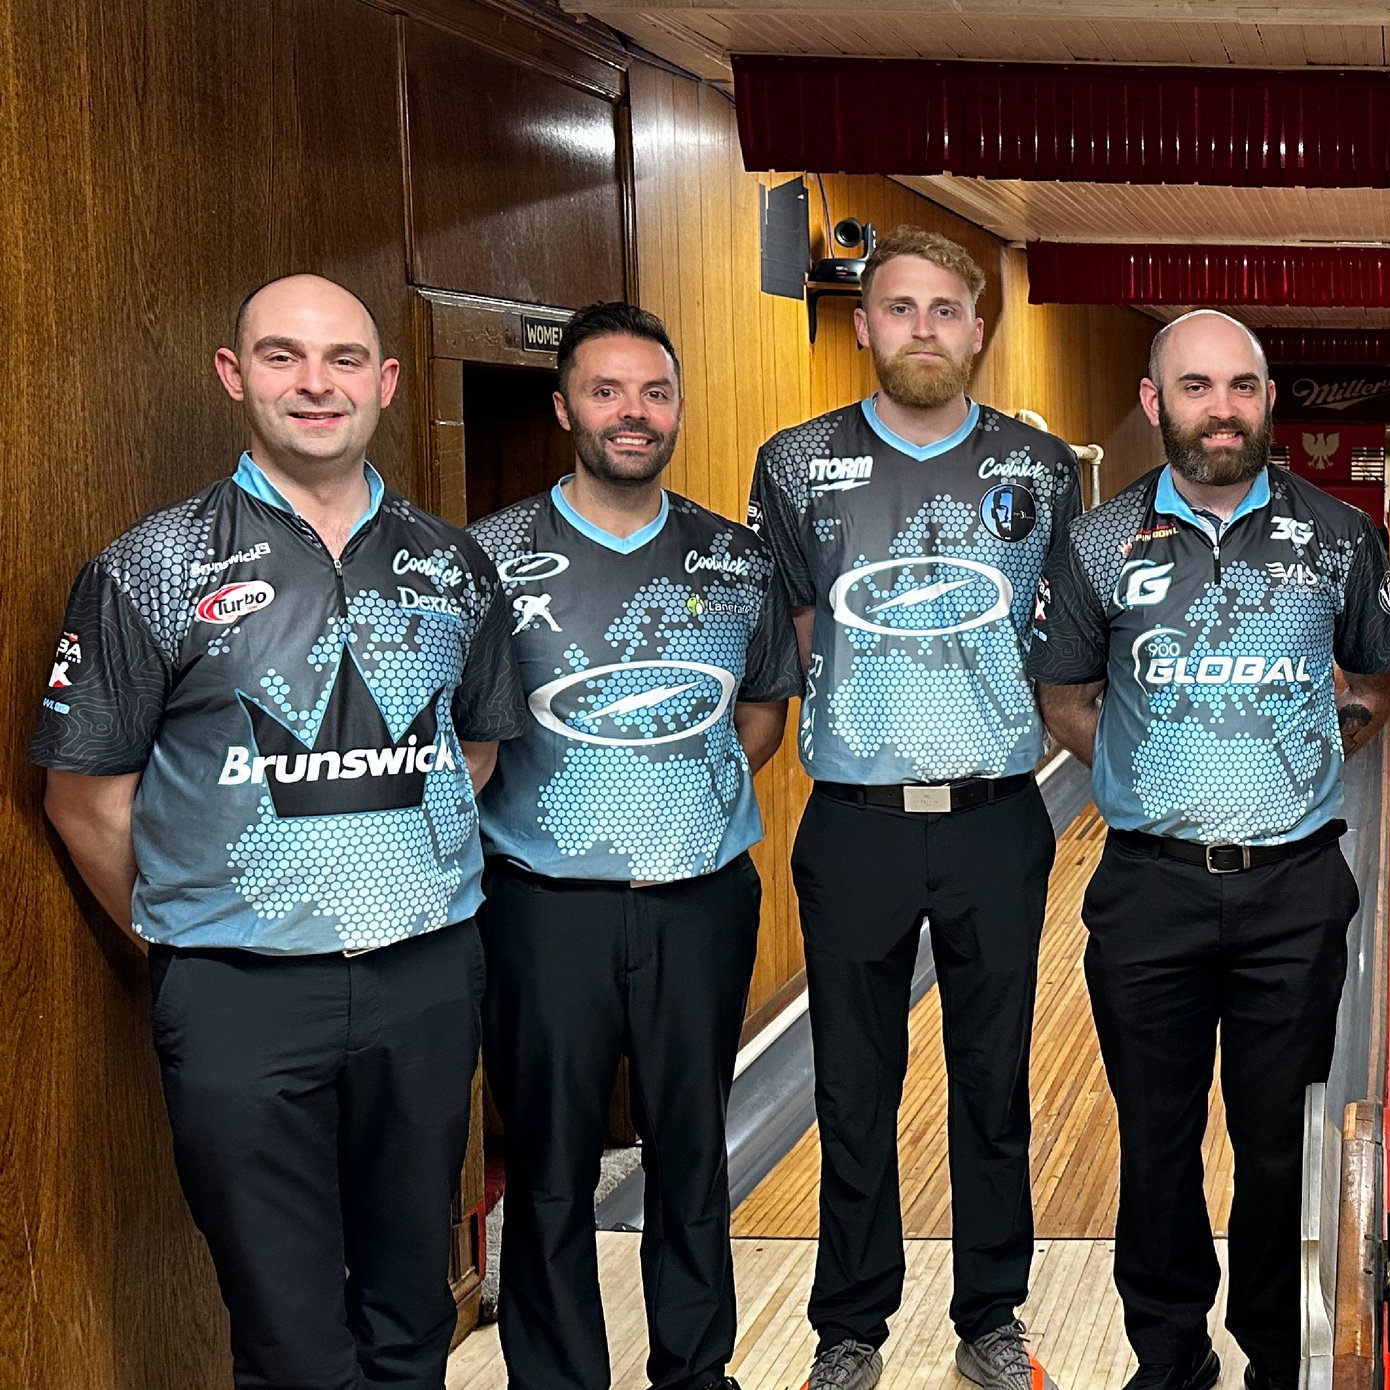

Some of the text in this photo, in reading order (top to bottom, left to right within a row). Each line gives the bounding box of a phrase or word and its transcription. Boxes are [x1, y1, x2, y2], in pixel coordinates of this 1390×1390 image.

[809, 455, 874, 480] STORM
[1269, 515, 1314, 545] 3G
[189, 547, 262, 574] Brunswick
[214, 591, 267, 616] Turbo
[1147, 642, 1180, 657] 900
[1145, 655, 1311, 685] GLOBAL
[218, 734, 456, 785] Brunswick
